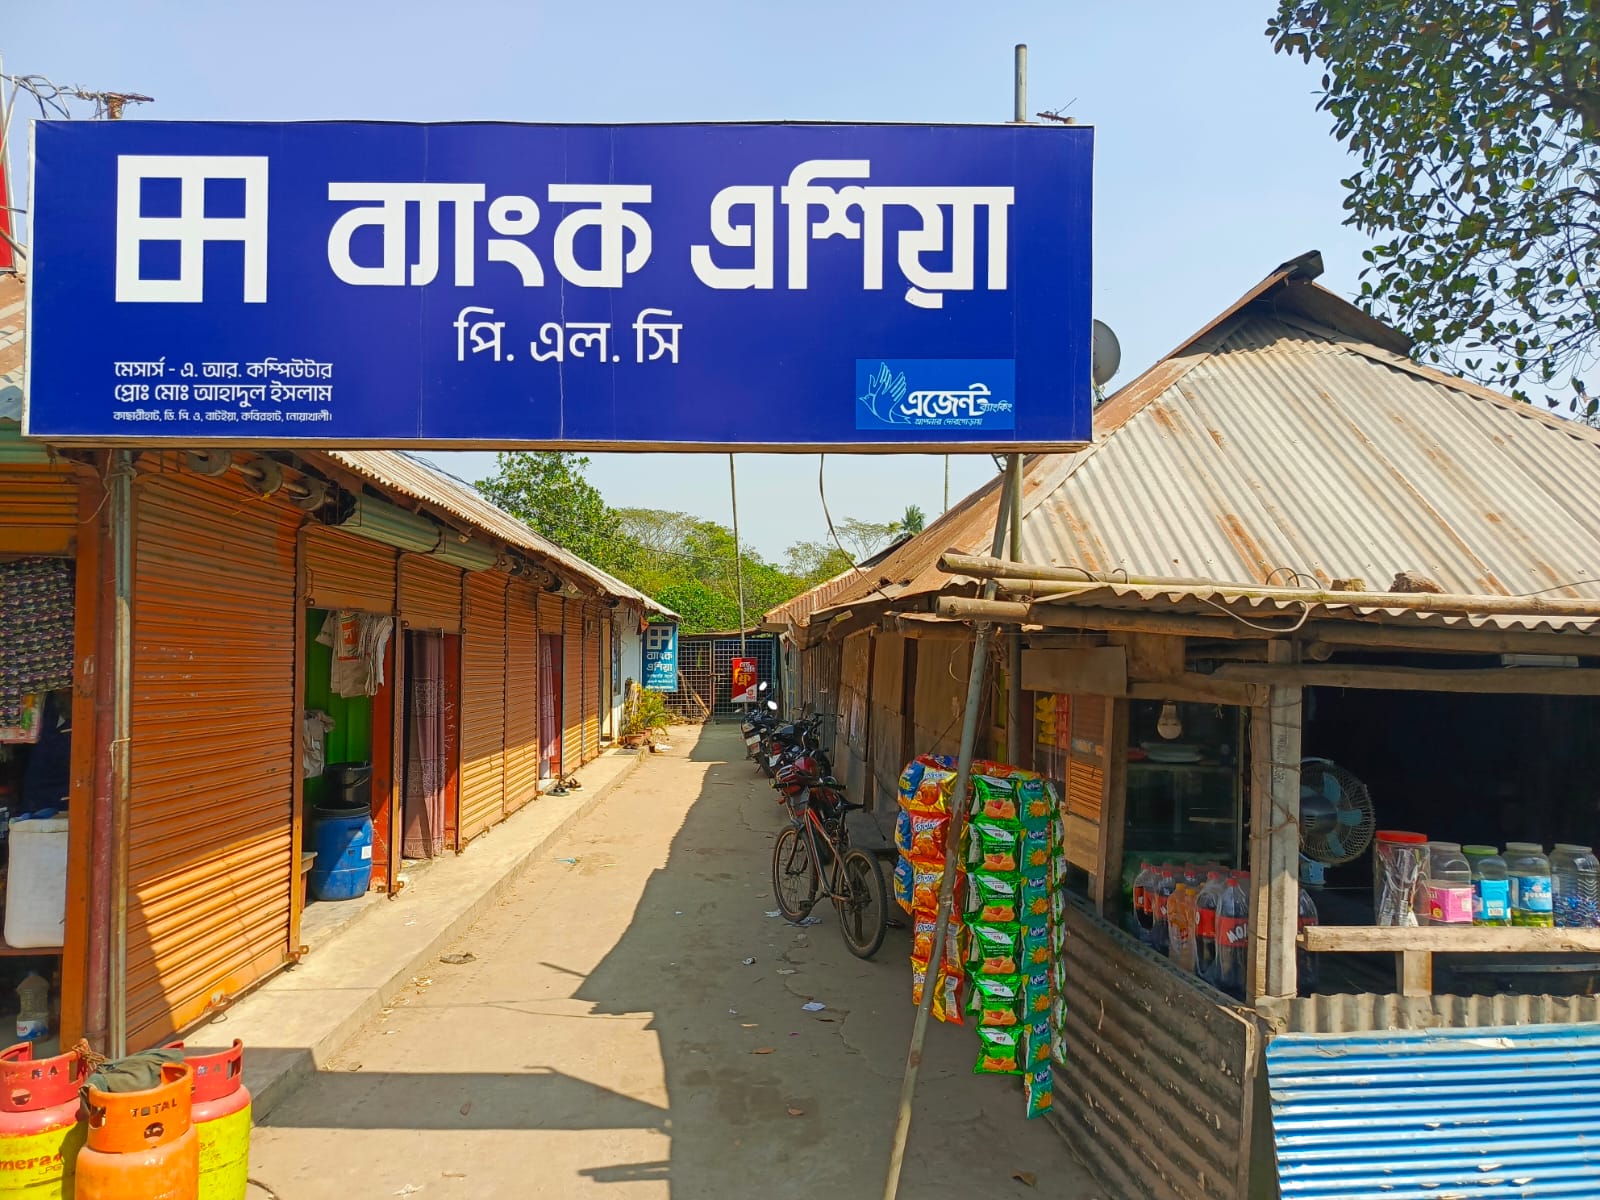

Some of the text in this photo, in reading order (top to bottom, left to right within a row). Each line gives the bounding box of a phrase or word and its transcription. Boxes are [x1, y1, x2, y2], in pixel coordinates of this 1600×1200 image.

[327, 159, 1015, 309] ব্যাংক এশিয়া
[453, 306, 683, 365] পি. এল. সি
[113, 357, 165, 378] মেসার্স
[180, 363, 198, 378] এ.
[202, 363, 242, 379] আর.
[245, 357, 334, 380] কম্পিউটার
[154, 384, 189, 401] মোঃ
[193, 384, 267, 408] আহাদুল
[269, 380, 334, 402] ইসলাম
[900, 383, 991, 417] এজেন্ট
[131, 1098, 178, 1118] TOTAL
